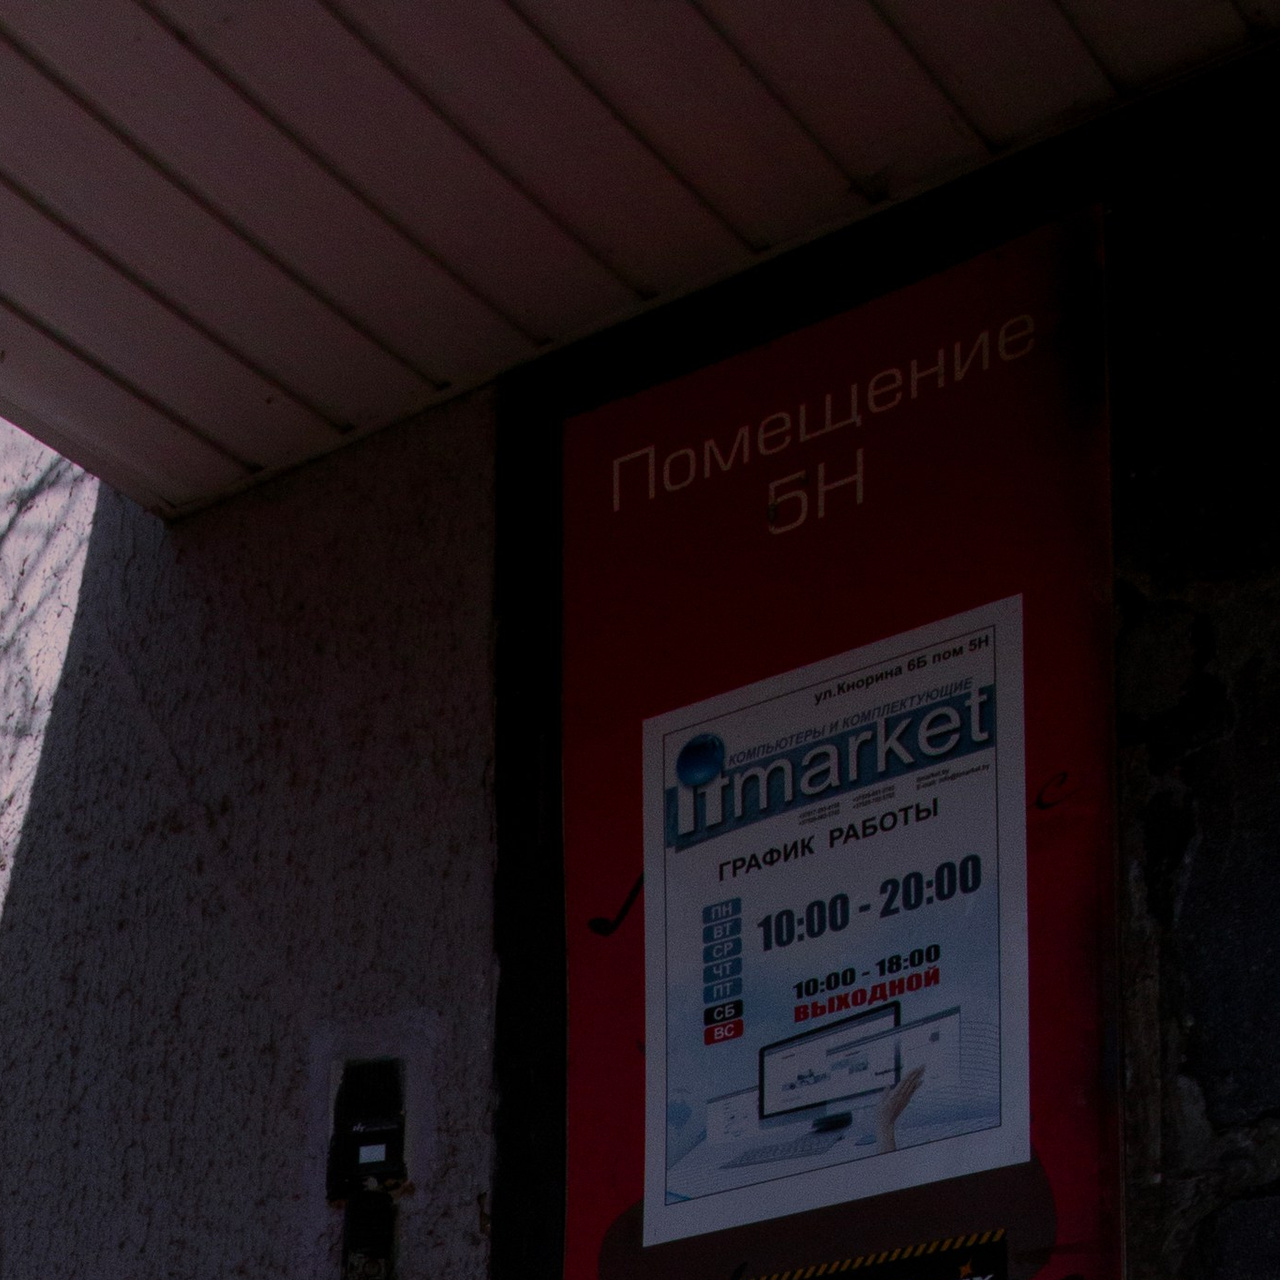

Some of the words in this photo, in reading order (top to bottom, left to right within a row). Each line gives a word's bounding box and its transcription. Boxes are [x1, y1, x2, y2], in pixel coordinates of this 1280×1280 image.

[611, 313, 1037, 512] Помещение
[767, 447, 865, 536] 5Н
[814, 664, 903, 706] ул.Кнорина
[907, 655, 928, 672] 6Б
[932, 645, 964, 665] пом
[968, 634, 990, 652] 5Н
[728, 723, 826, 766] КОМПЬЮТЕРЫ
[828, 720, 839, 735] И
[842, 677, 974, 730] КОМПЛЕКТУЮЩИЕ
[719, 836, 816, 882] ГРАФИК
[828, 797, 939, 849] РАБОТЫ
[711, 902, 733, 920] ПН
[713, 922, 733, 940] ВТ
[757, 892, 850, 952] 10:00
[879, 853, 983, 919] 20:00
[712, 941, 734, 959] СР
[713, 961, 733, 978] ЧТ
[793, 967, 856, 1000] 10:00
[875, 943, 941, 977] 18:00
[713, 980, 734, 999] ПТ
[713, 1003, 736, 1021] СБ
[793, 964, 941, 1024] ВЫХОДНОЙ
[713, 1022, 736, 1041] ВС
